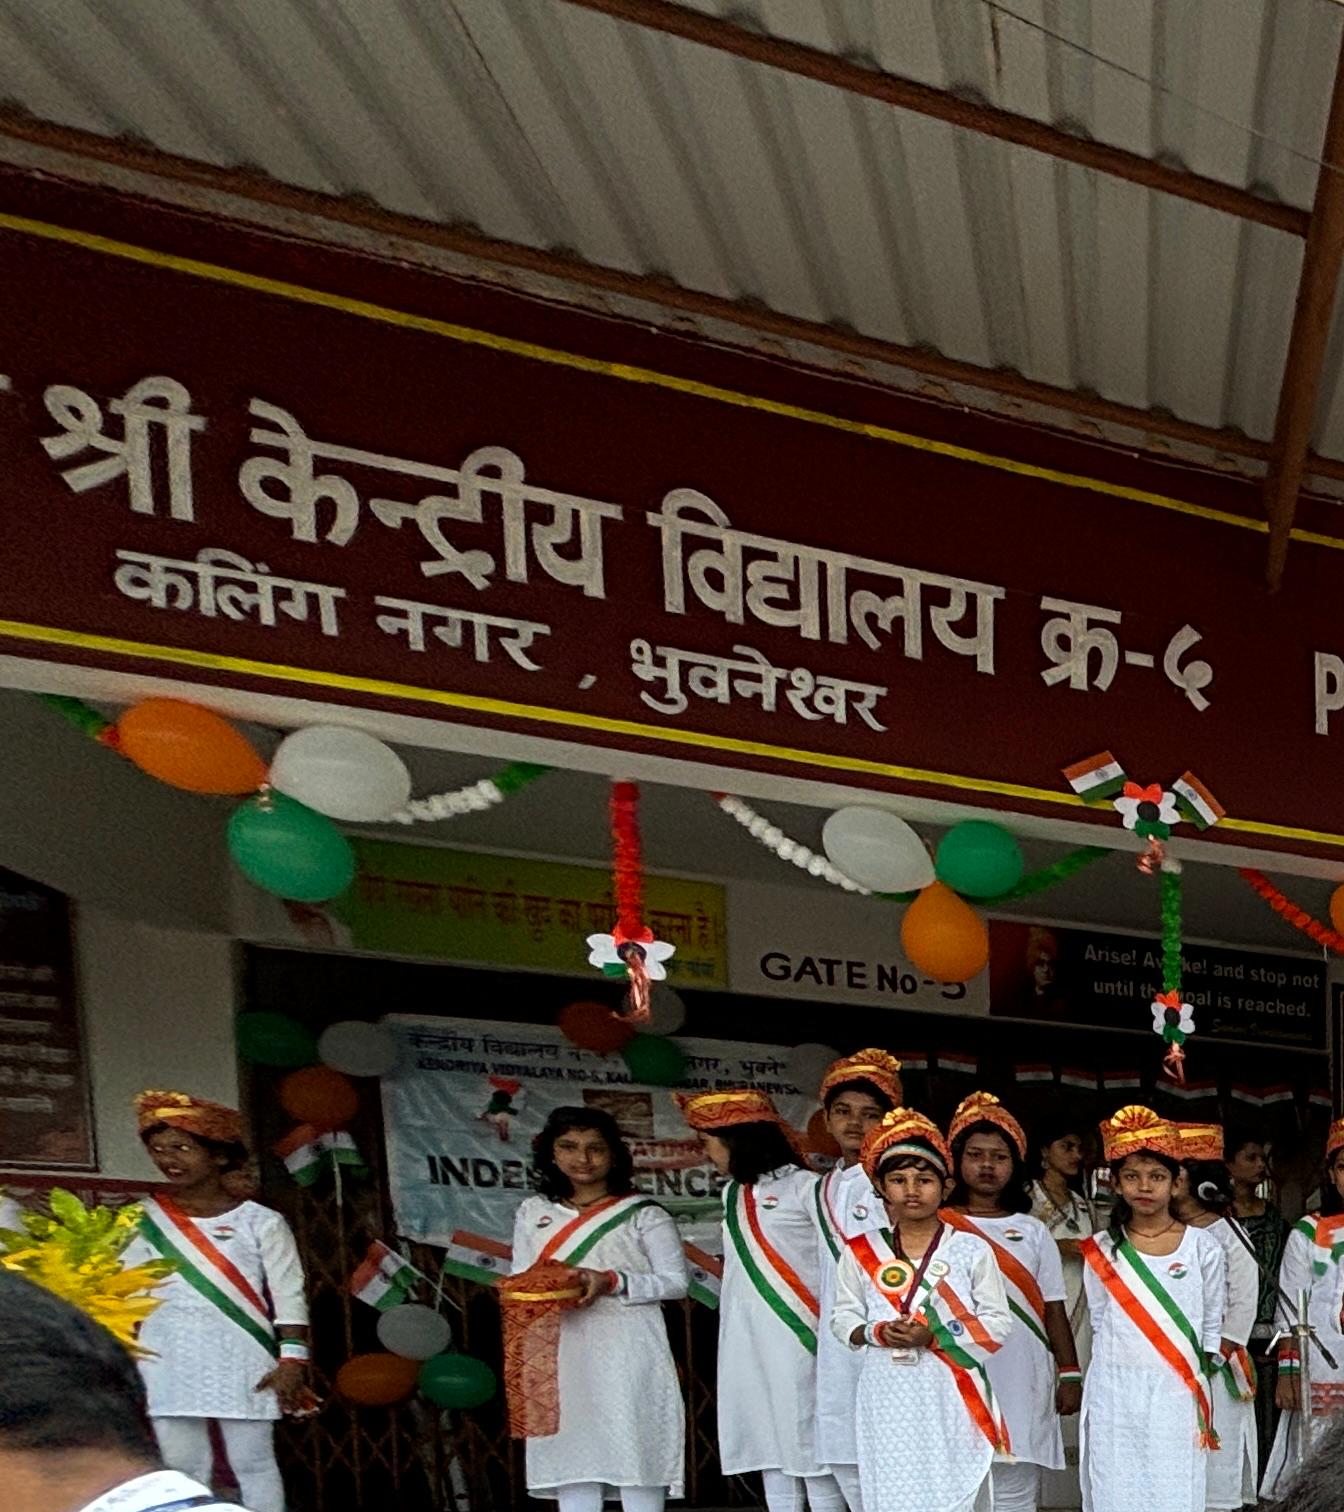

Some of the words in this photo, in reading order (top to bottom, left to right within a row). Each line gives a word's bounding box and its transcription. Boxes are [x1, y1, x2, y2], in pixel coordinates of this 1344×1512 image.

[39, 375, 207, 522] श्री
[238, 398, 623, 600] केन्द्रीय
[645, 487, 1006, 675] विद्यालय
[115, 548, 345, 636] कलिंग
[630, 638, 888, 732] भुवनेश्वर
[760, 952, 867, 989] GATE
[1084, 944, 1137, 966] Arise!
[1213, 962, 1244, 981] and
[1250, 966, 1287, 988] stop
[1292, 973, 1320, 990] not
[1093, 978, 1135, 999] until
[1180, 990, 1211, 1007] oal
[1217, 992, 1232, 1008] is
[1238, 995, 1312, 1018] reached.
